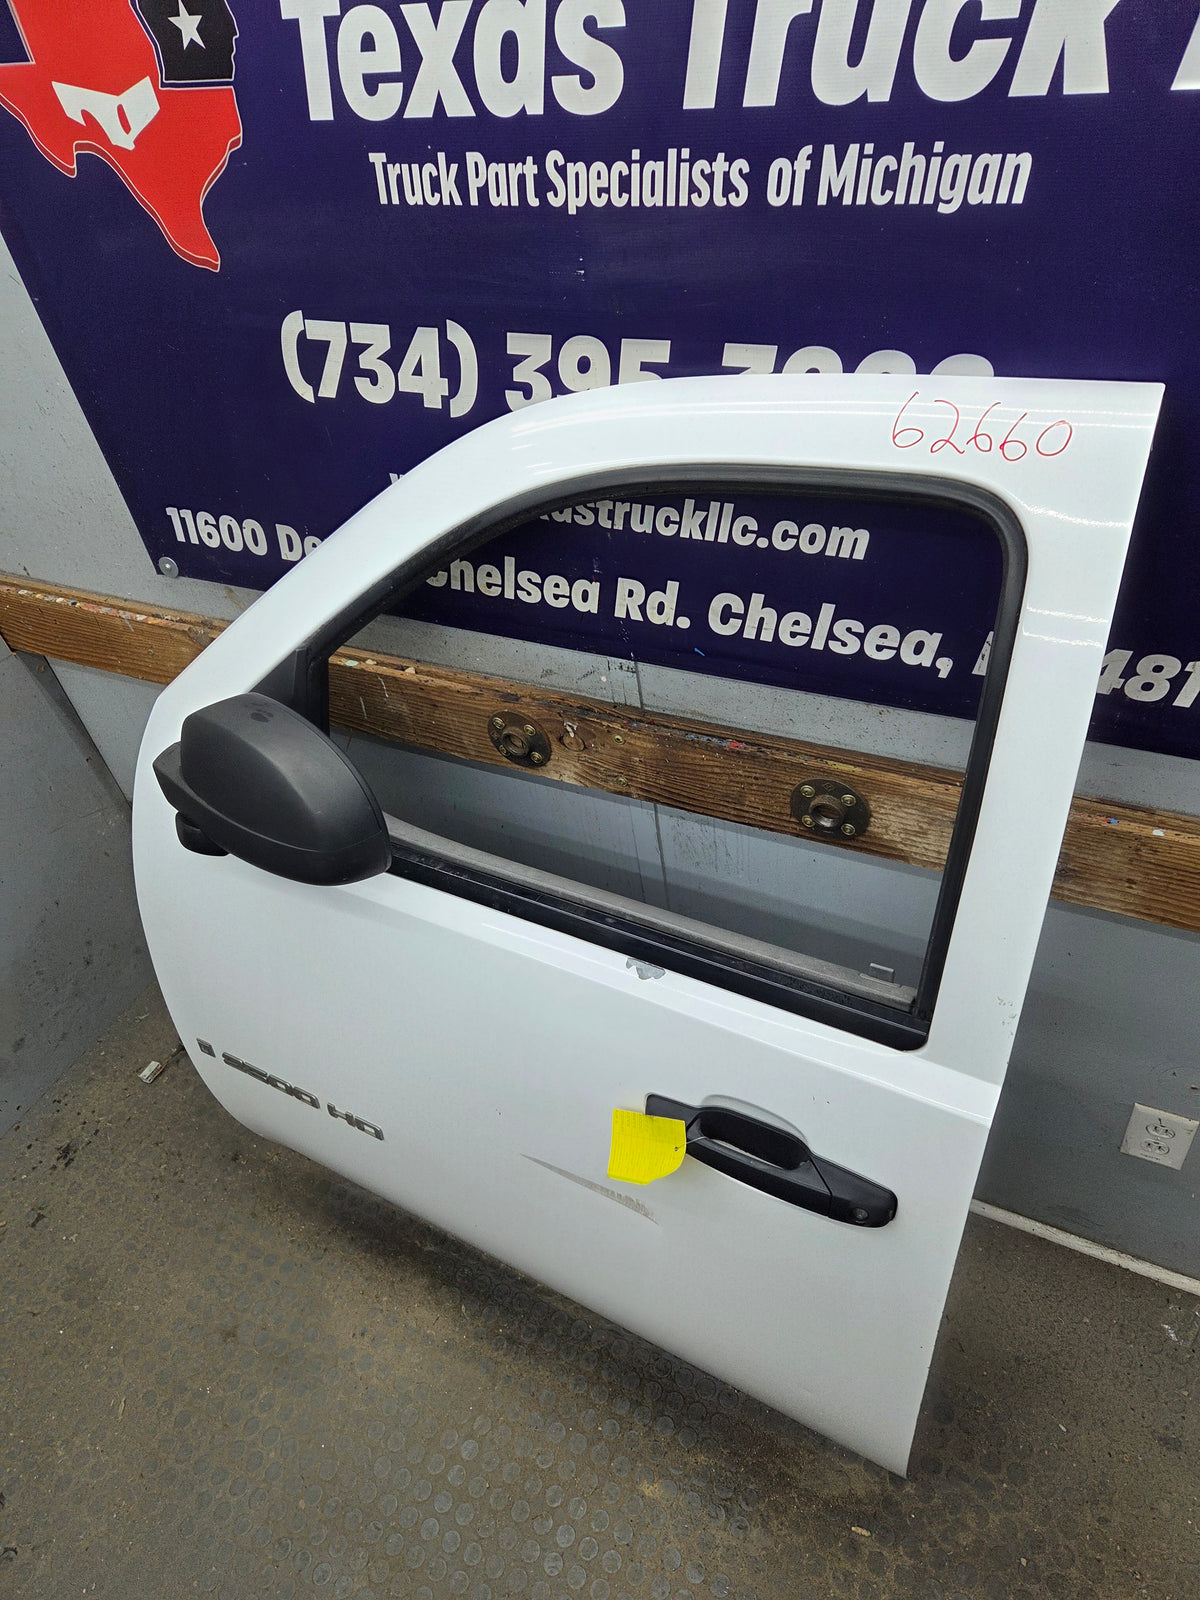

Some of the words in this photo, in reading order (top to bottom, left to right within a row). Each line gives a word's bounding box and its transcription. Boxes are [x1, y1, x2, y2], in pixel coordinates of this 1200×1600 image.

[279, 0, 627, 122] Texas
[682, 0, 1121, 110] Truck
[368, 151, 463, 206] Truck
[465, 151, 540, 207] Part
[545, 147, 750, 215] Specialists
[766, 144, 813, 207] of
[816, 141, 1033, 215] Michigan
[280, 309, 479, 418] (734)
[892, 391, 1072, 462] 62660
[165, 506, 268, 556] 11600
[613, 577, 691, 629] Rd.
[707, 592, 954, 679] Chelsea,
[327, 1102, 385, 1141] HD
